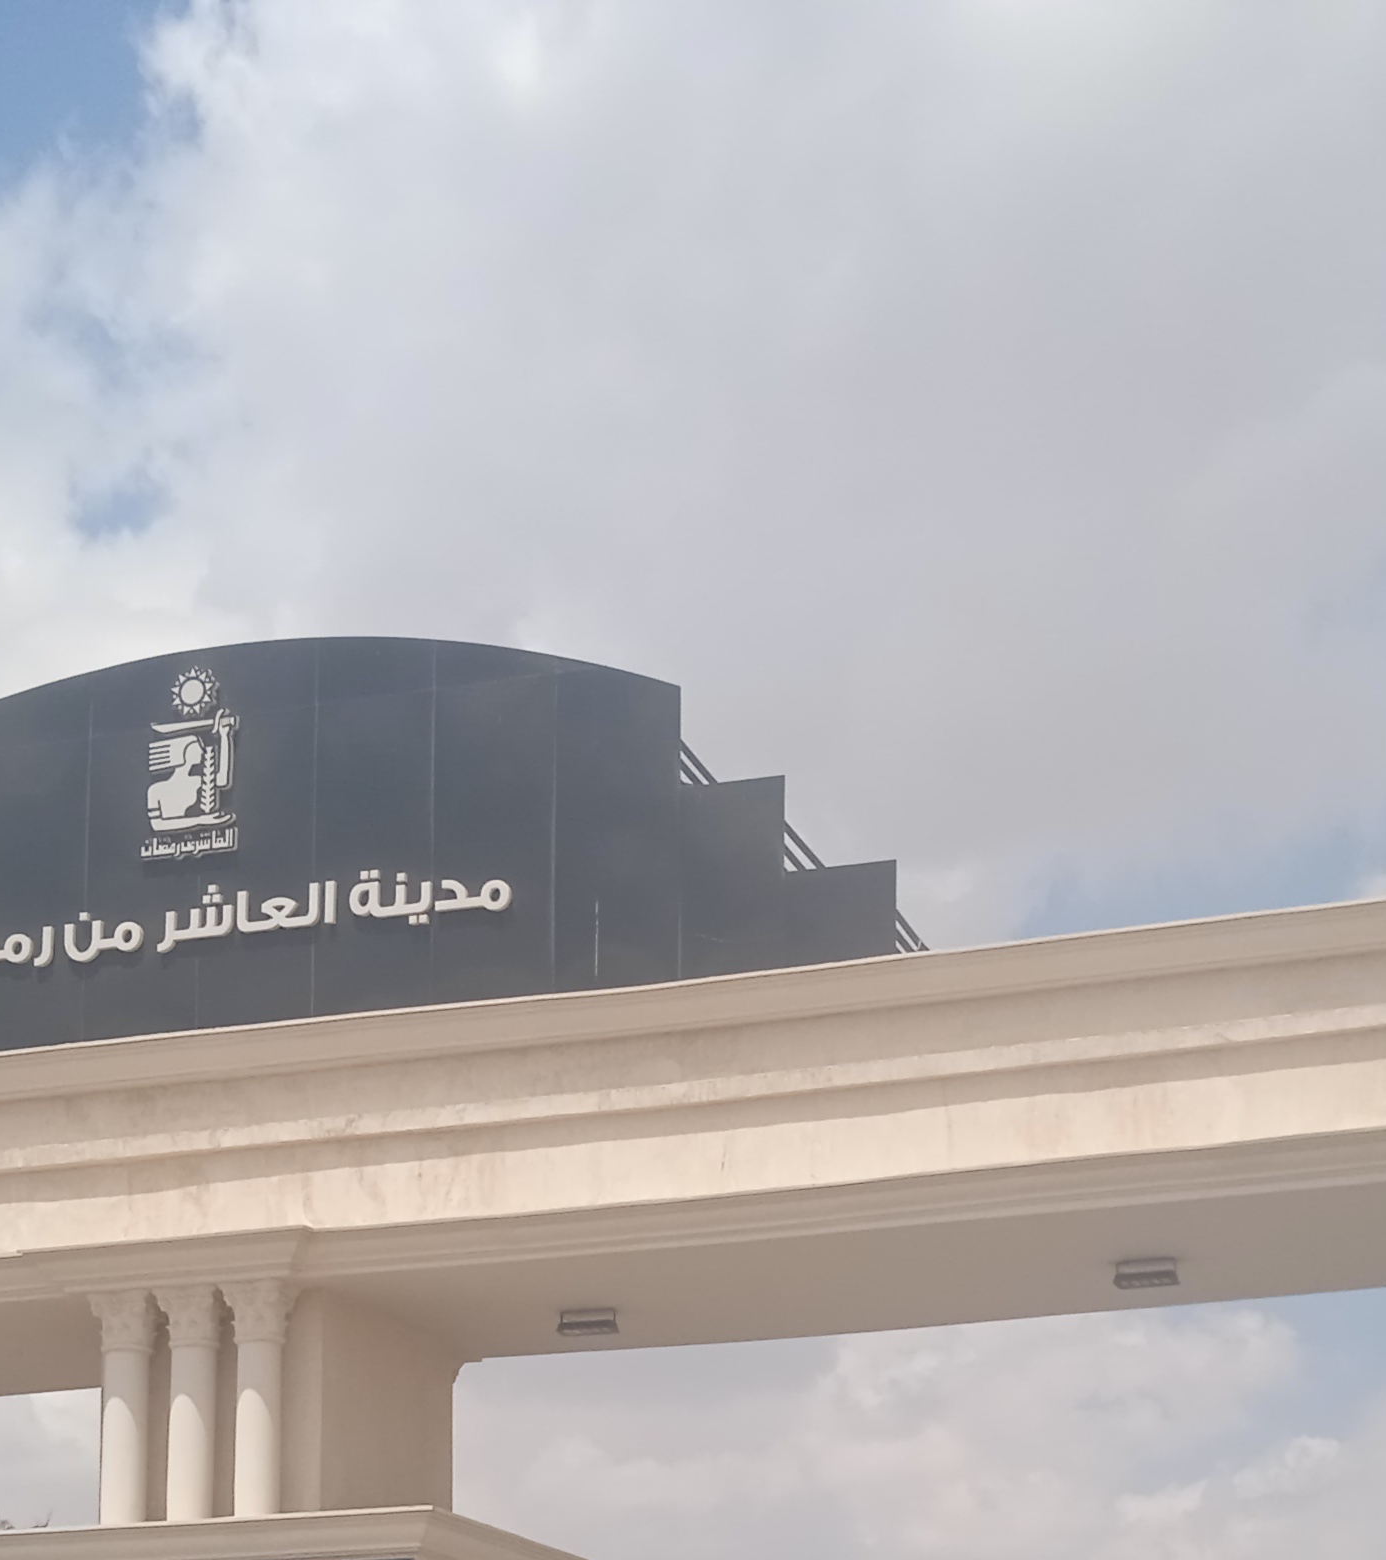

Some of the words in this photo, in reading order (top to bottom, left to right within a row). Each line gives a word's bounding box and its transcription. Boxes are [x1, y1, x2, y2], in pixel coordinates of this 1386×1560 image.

[157, 881, 337, 953] العاشر
[348, 868, 512, 926] مدينة
[63, 911, 145, 963] من
